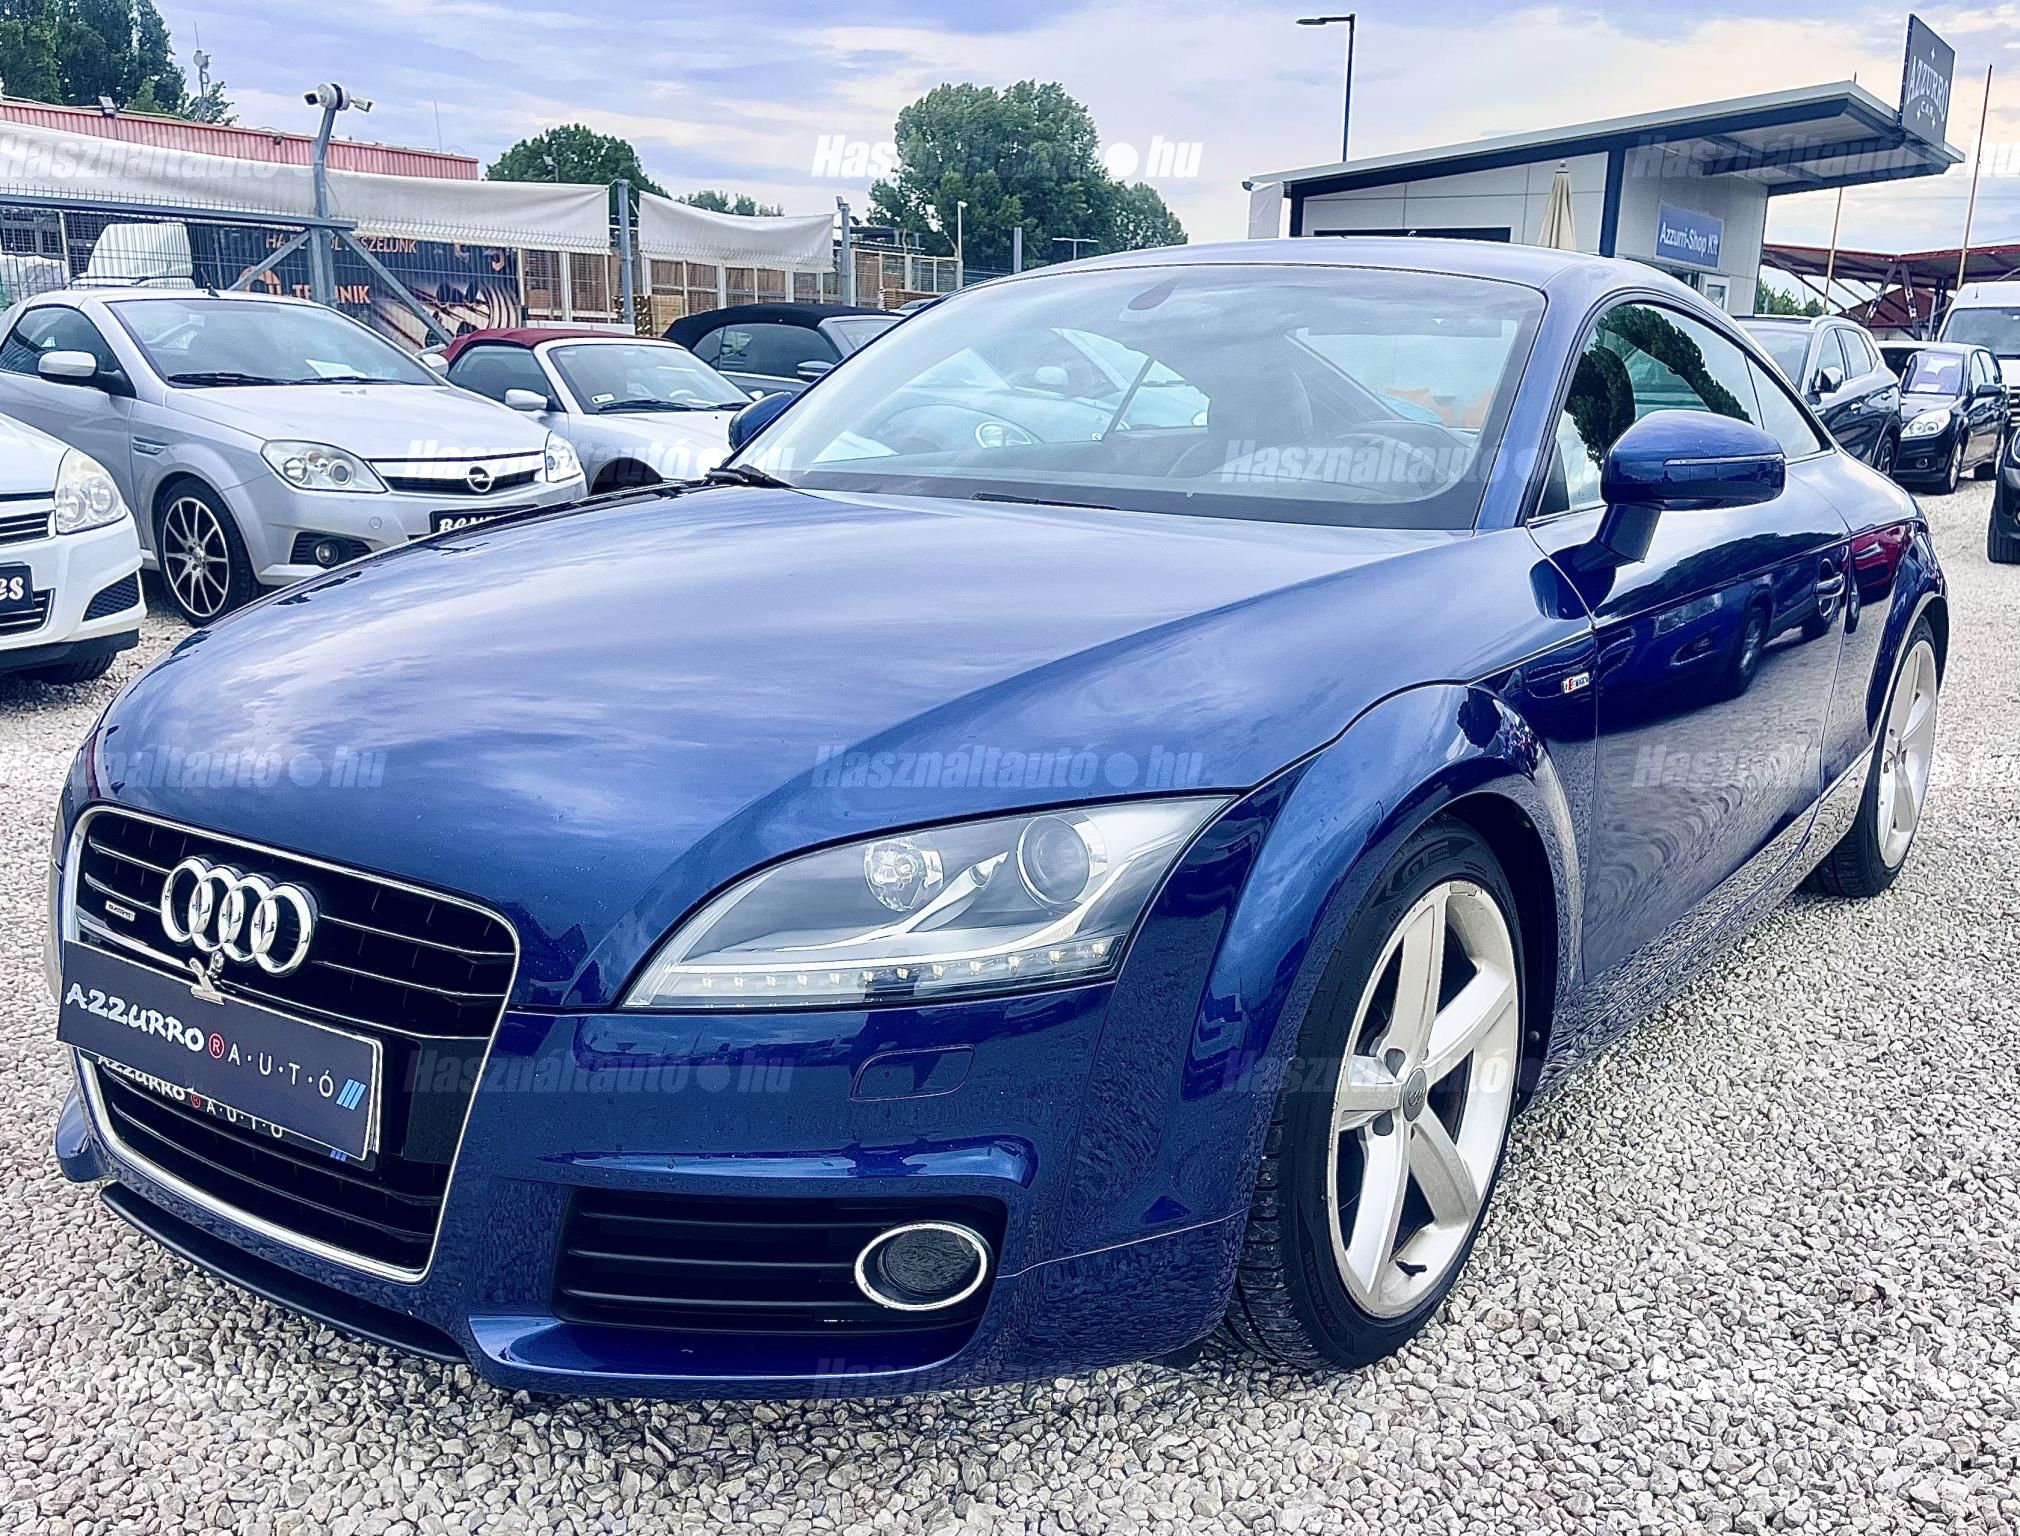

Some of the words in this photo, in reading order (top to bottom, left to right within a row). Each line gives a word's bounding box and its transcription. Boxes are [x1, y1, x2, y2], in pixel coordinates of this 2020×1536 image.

[1906, 56, 1949, 122] AZZURRO
[1920, 101, 1934, 118] CAR
[65, 982, 205, 1052] AZZURRO
